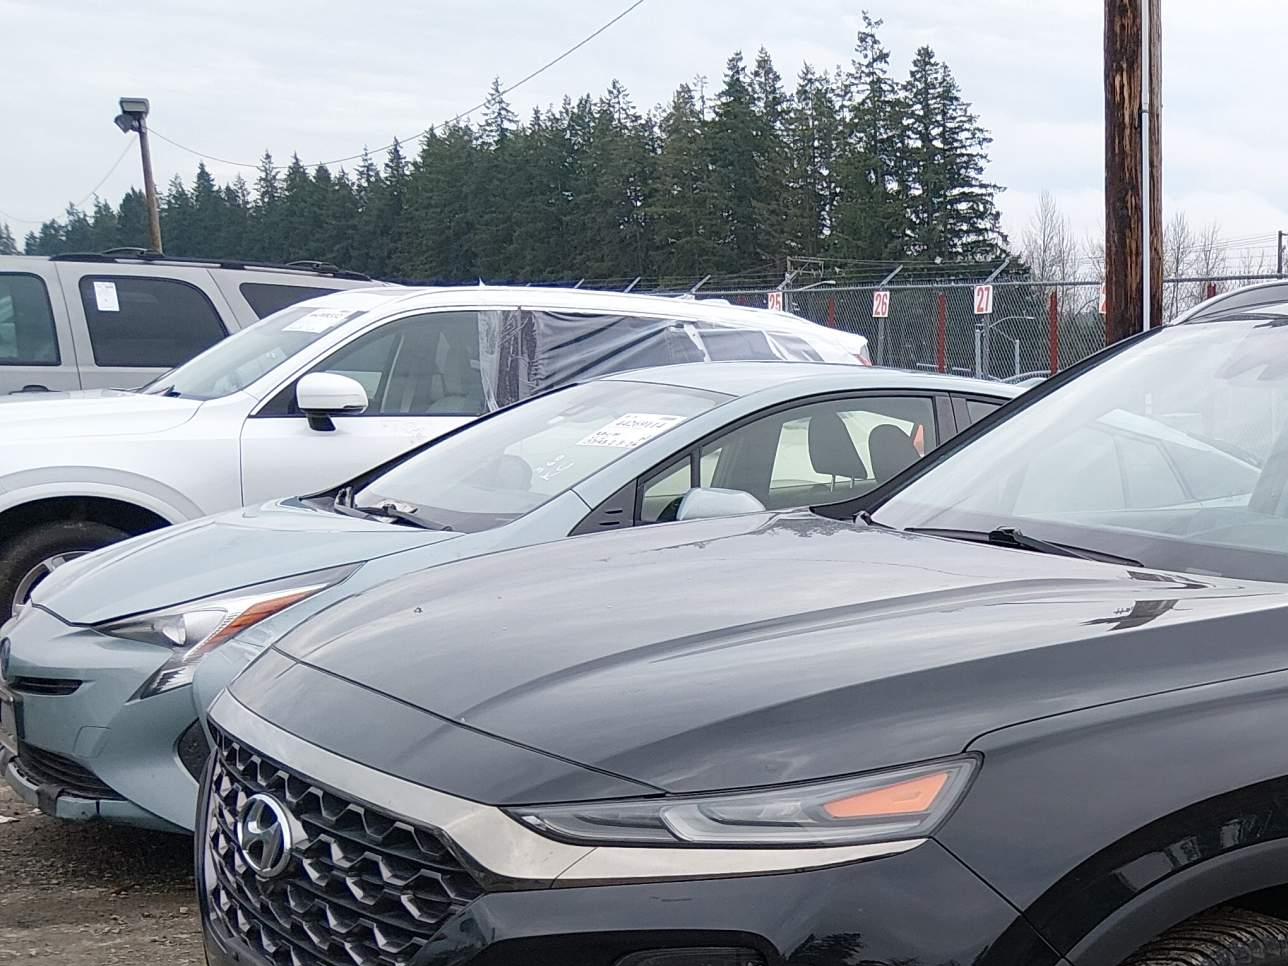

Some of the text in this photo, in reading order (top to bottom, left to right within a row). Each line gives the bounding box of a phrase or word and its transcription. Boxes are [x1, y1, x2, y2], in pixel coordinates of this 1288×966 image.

[769, 293, 782, 311] 25
[874, 293, 888, 316] 26
[976, 286, 991, 313] 27
